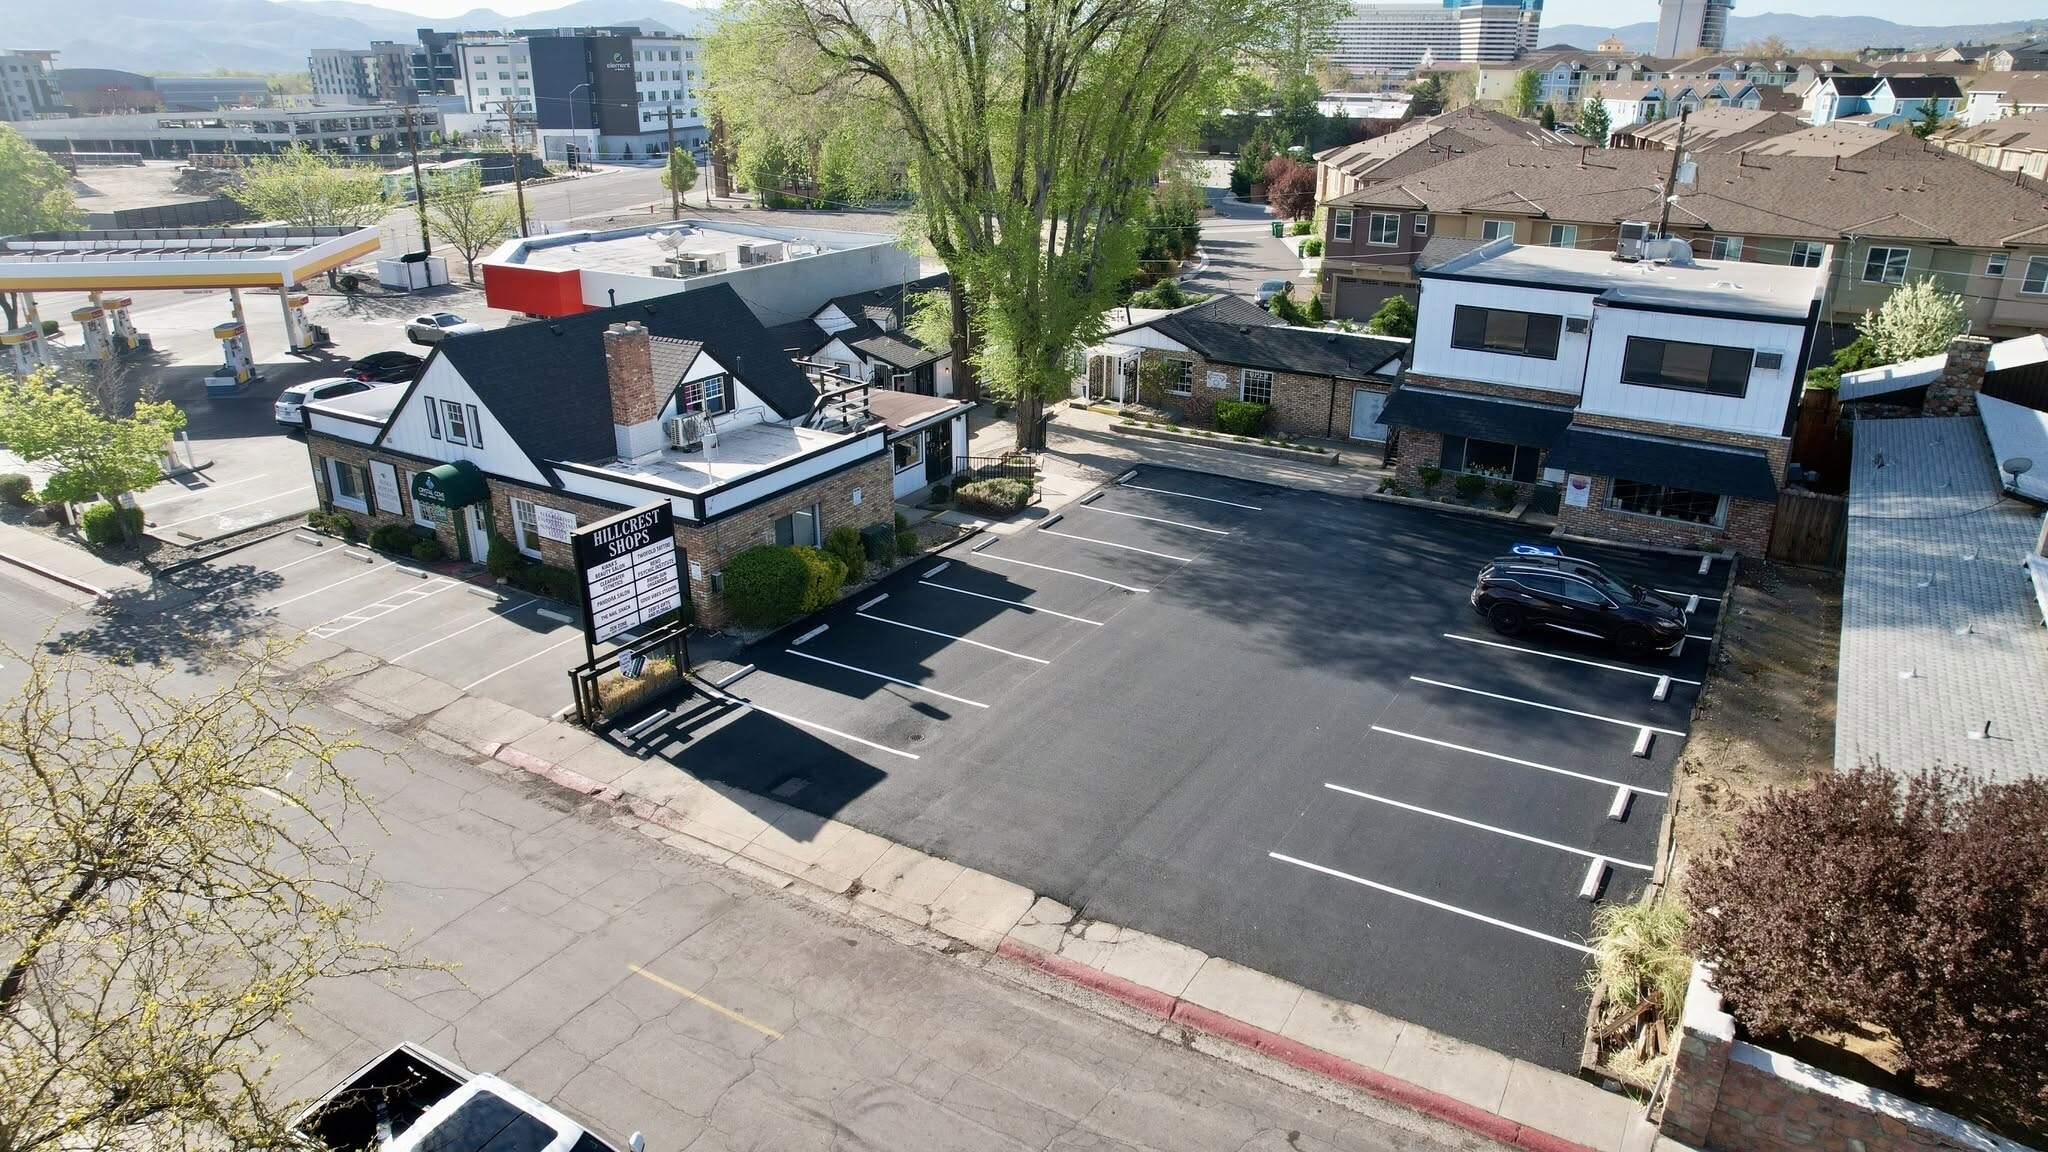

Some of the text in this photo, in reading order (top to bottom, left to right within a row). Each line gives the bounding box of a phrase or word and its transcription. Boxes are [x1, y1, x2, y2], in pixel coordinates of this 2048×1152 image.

[418, 487, 434, 496] CRYSTAL
[593, 509, 659, 546] HILLCREST
[609, 529, 650, 556] SHOPS
[637, 542, 670, 559] TWOFOLD TATTOO
[638, 558, 673, 576] PSYCHIC INSTITUTE
[650, 558, 660, 566] RENO
[595, 562, 625, 578] BEAUTY SALON
[600, 573, 624, 586] CLEARWATER
[646, 574, 658, 582] RISING
[603, 579, 622, 591] ESTHETICS
[597, 589, 630, 606] PANDORA SALON
[640, 595, 650, 603] GOOD
[618, 604, 630, 612] SHACK
[656, 604, 671, 614] FLORALS
